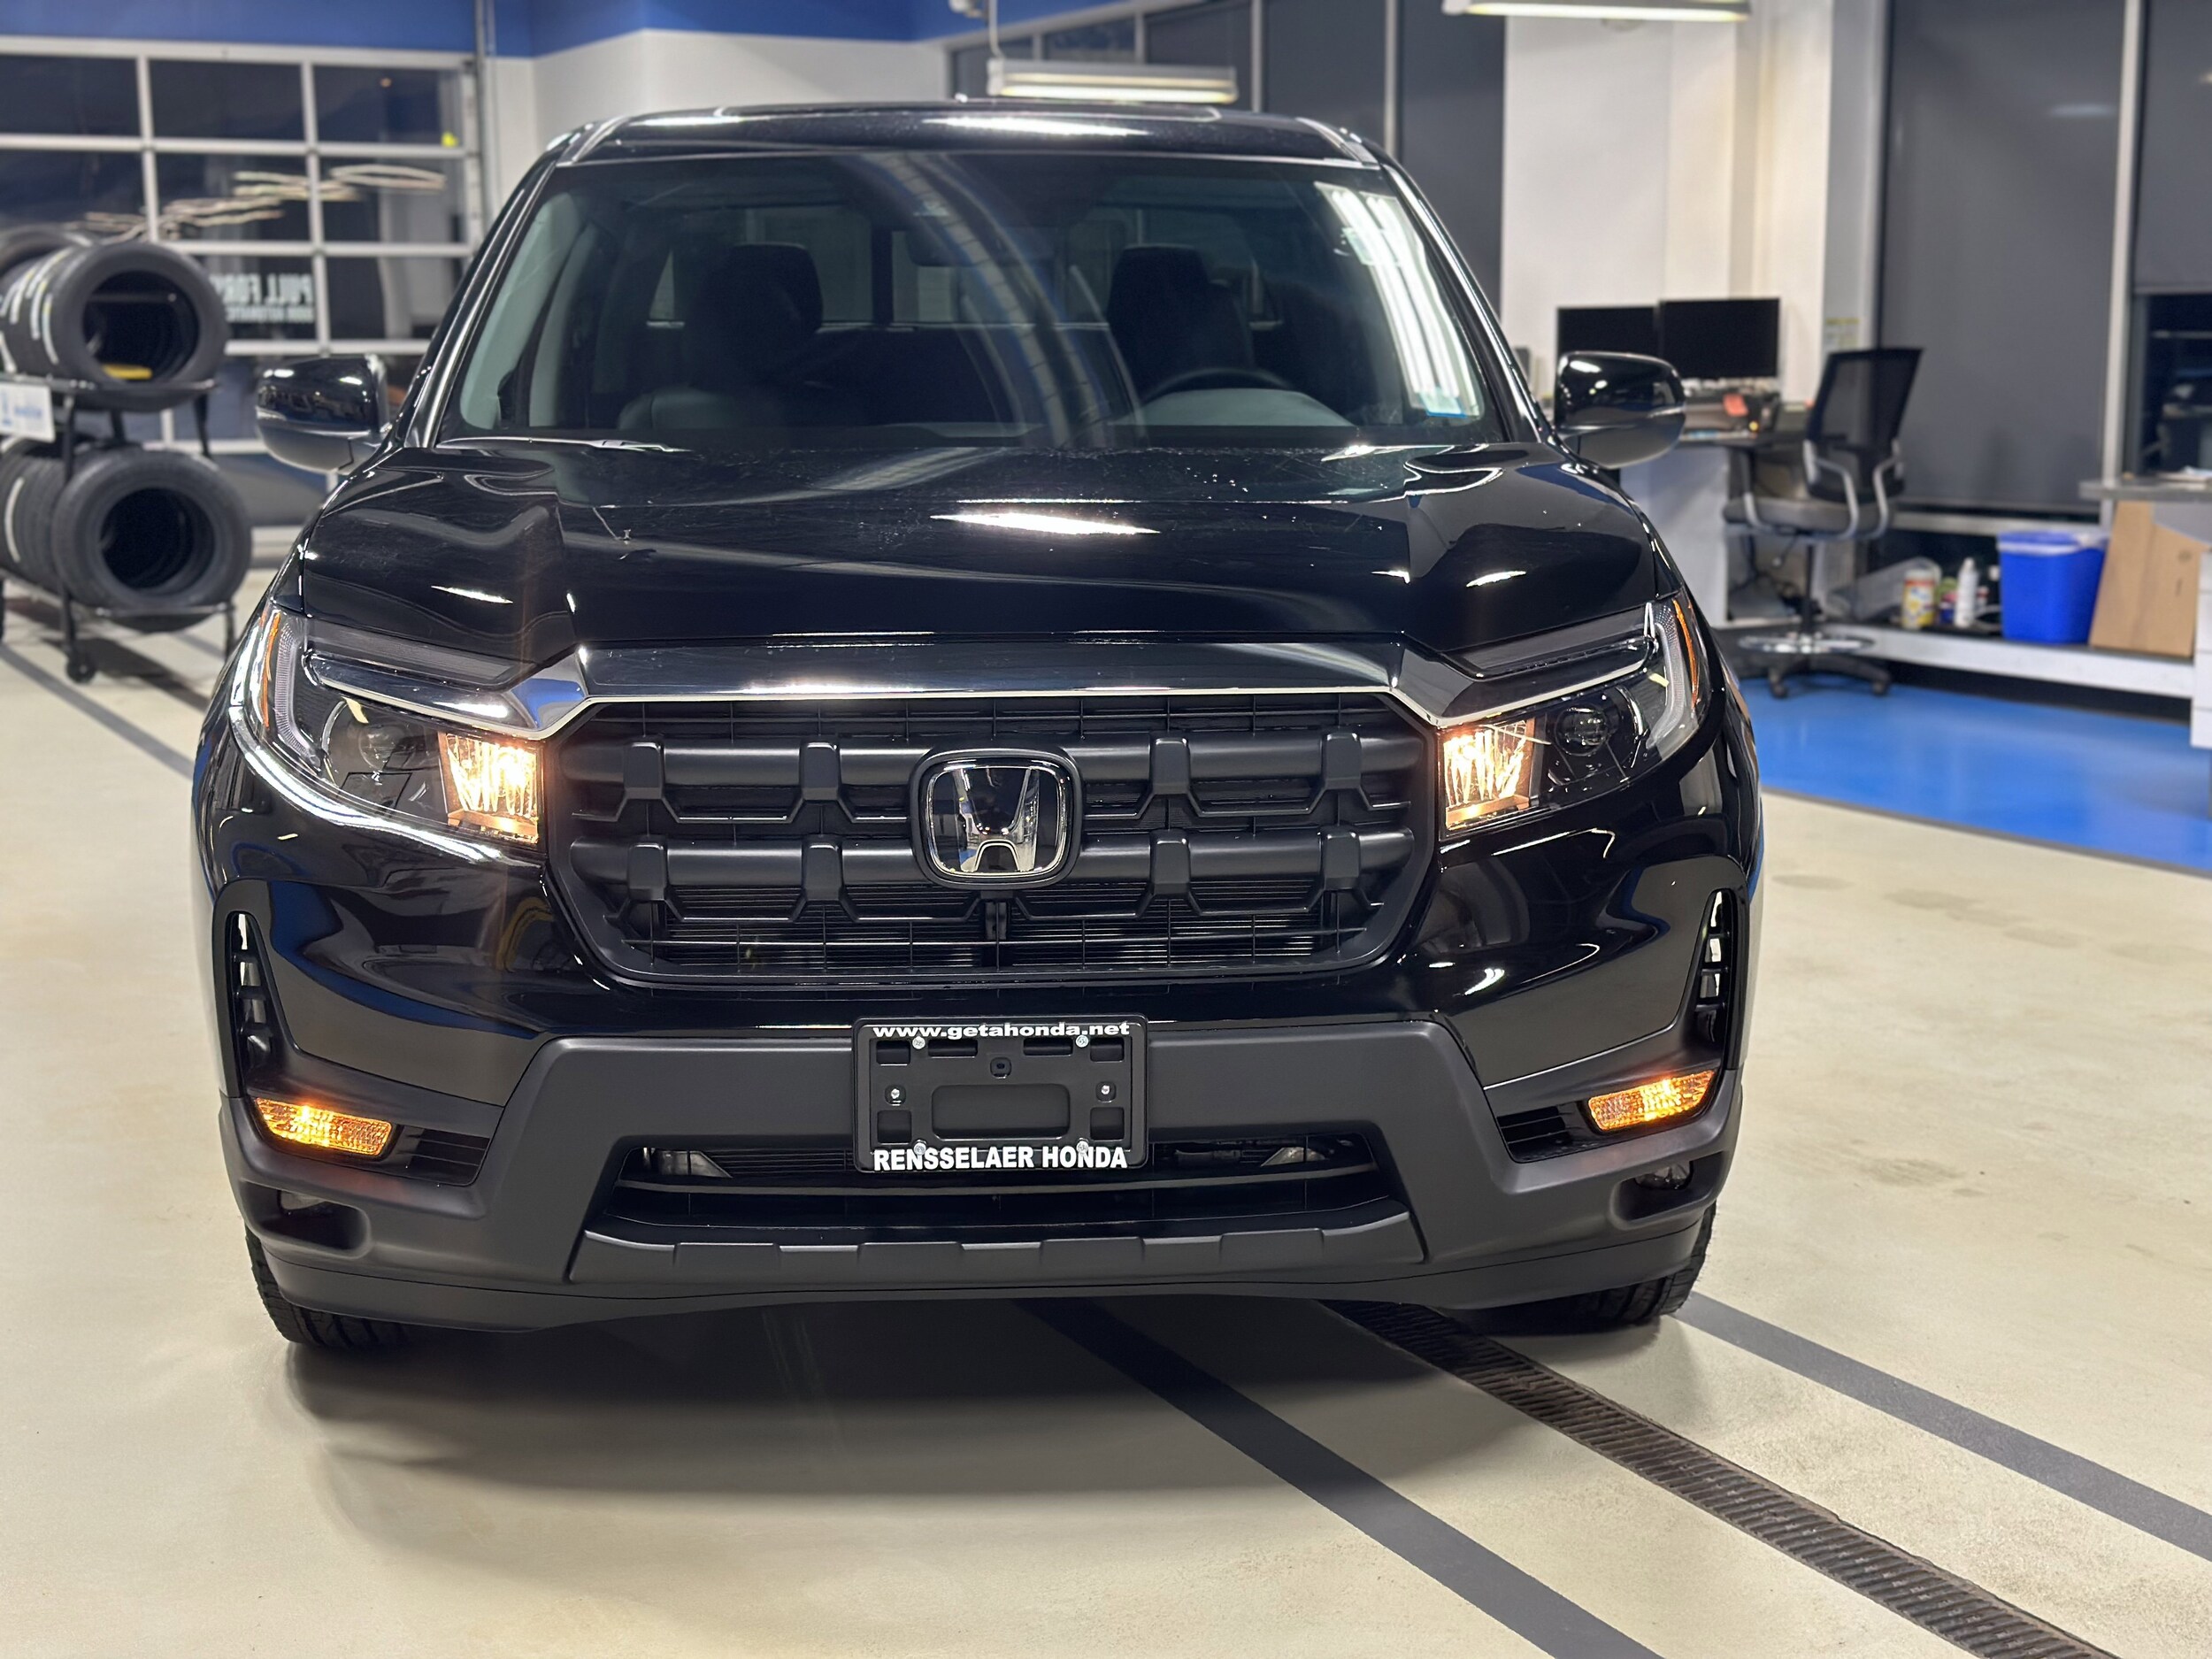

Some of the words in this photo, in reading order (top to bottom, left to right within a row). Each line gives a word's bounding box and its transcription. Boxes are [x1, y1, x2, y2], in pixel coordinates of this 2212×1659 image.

[872, 1023, 1130, 1038] www.getahonda.net
[873, 1148, 1034, 1171] RENSSELAER
[1042, 1147, 1127, 1169] HONDA
